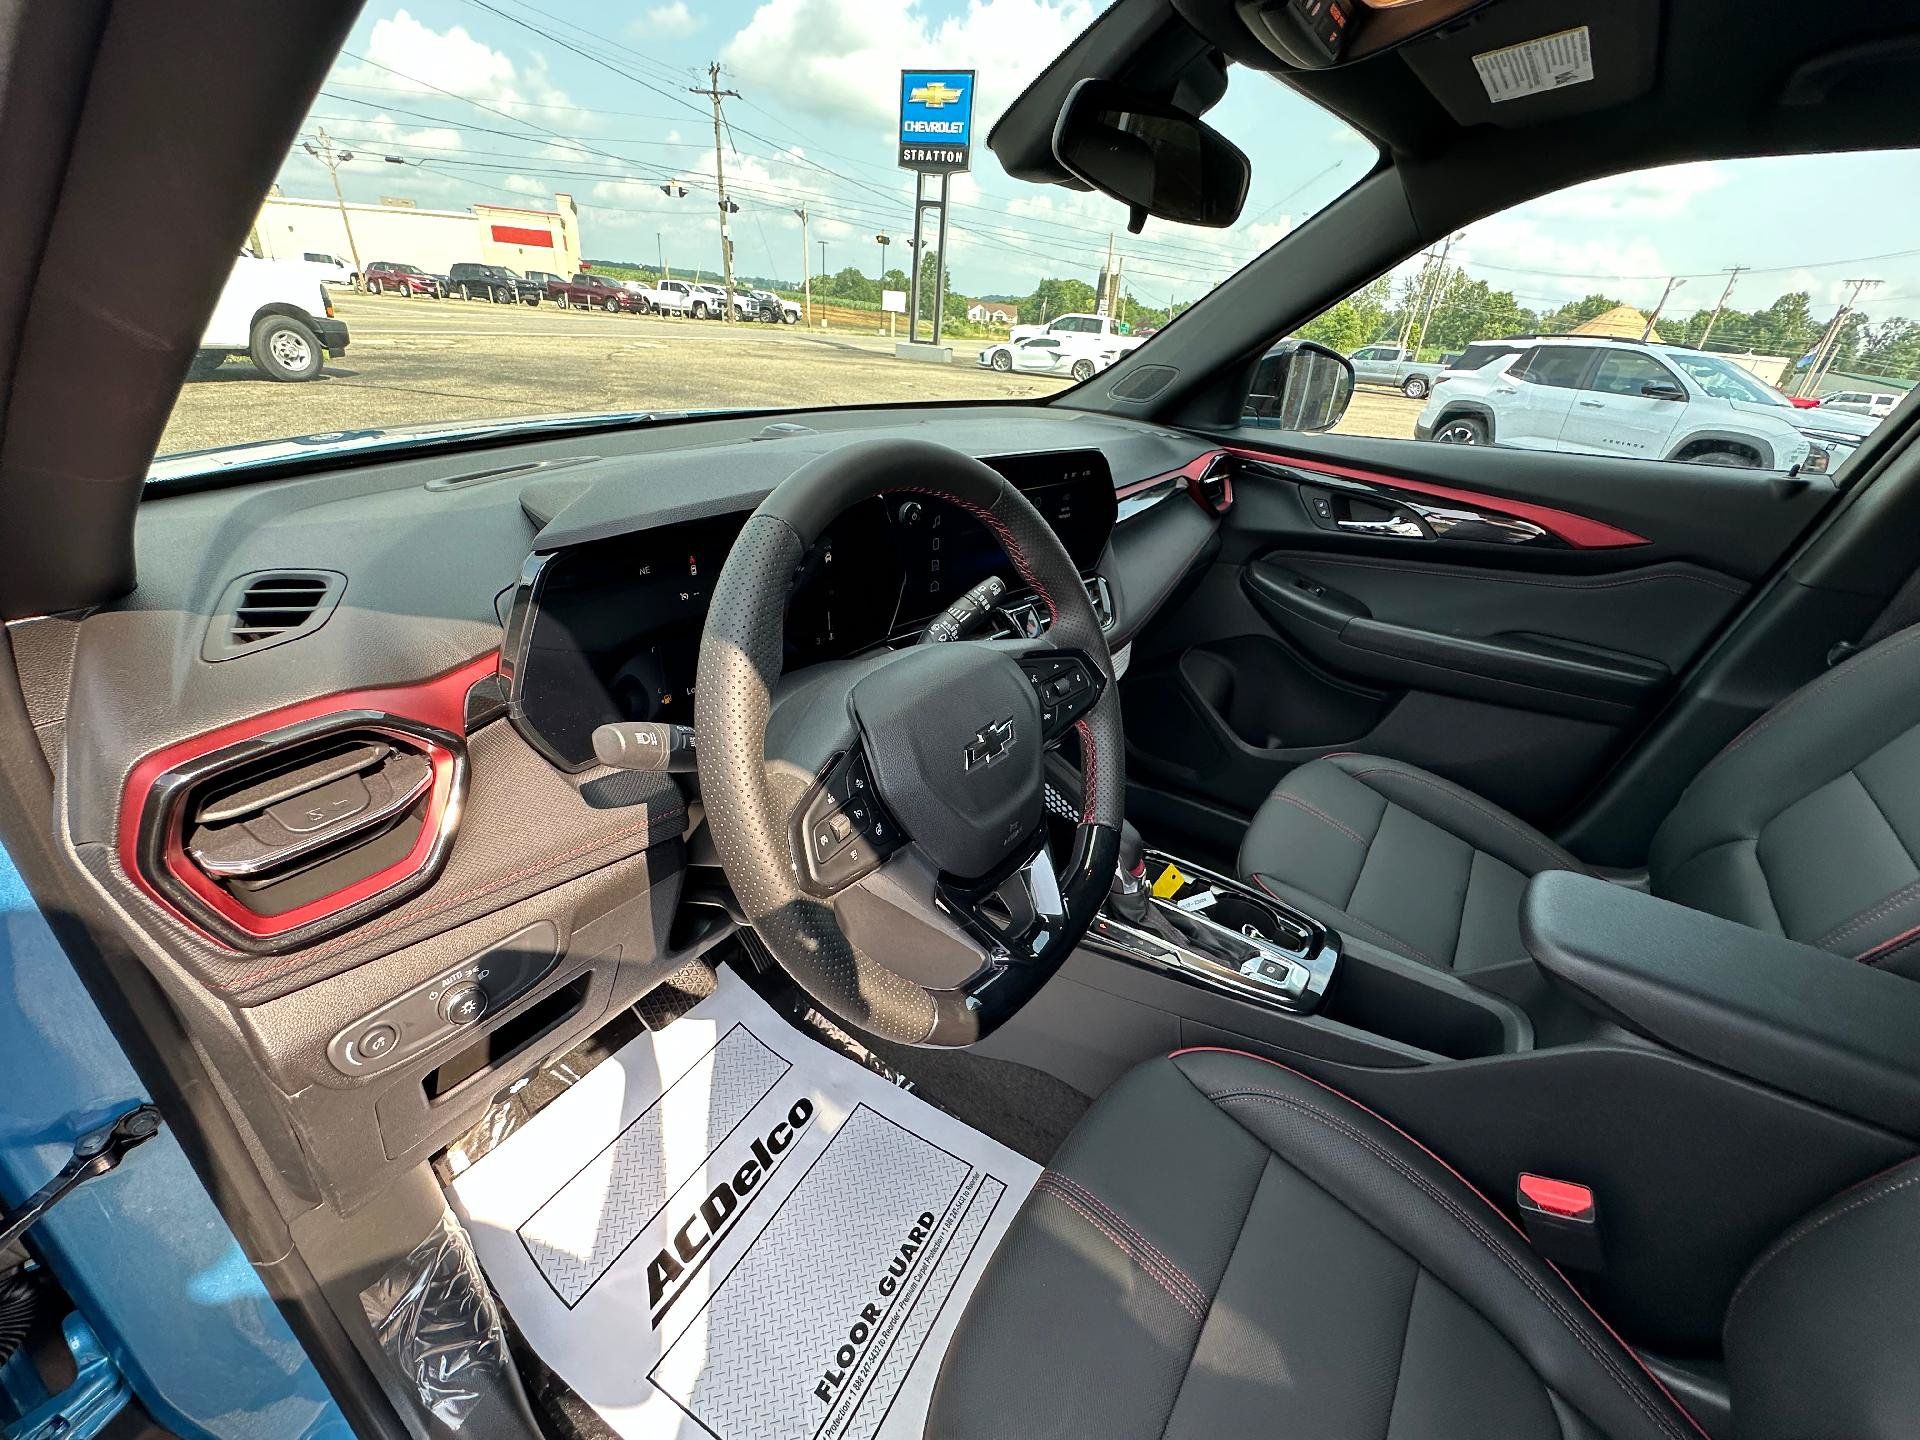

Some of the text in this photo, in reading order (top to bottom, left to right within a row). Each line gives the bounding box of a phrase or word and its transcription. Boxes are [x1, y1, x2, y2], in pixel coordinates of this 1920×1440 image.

[903, 149, 963, 163] STRATTON
[904, 120, 965, 134] CHEVROLET
[441, 971, 463, 988] AUTO
[646, 1097, 814, 1311] ACDelco
[813, 1211, 935, 1405] FLOOR GUARD
[824, 1400, 851, 1440] Protection
[878, 1337, 886, 1348] to
[884, 1313, 901, 1341] Reorder
[899, 1281, 918, 1311] Premium
[913, 1263, 930, 1284] Carpet
[924, 1234, 944, 1263] Protection
[965, 1171, 981, 1192] Reorder
